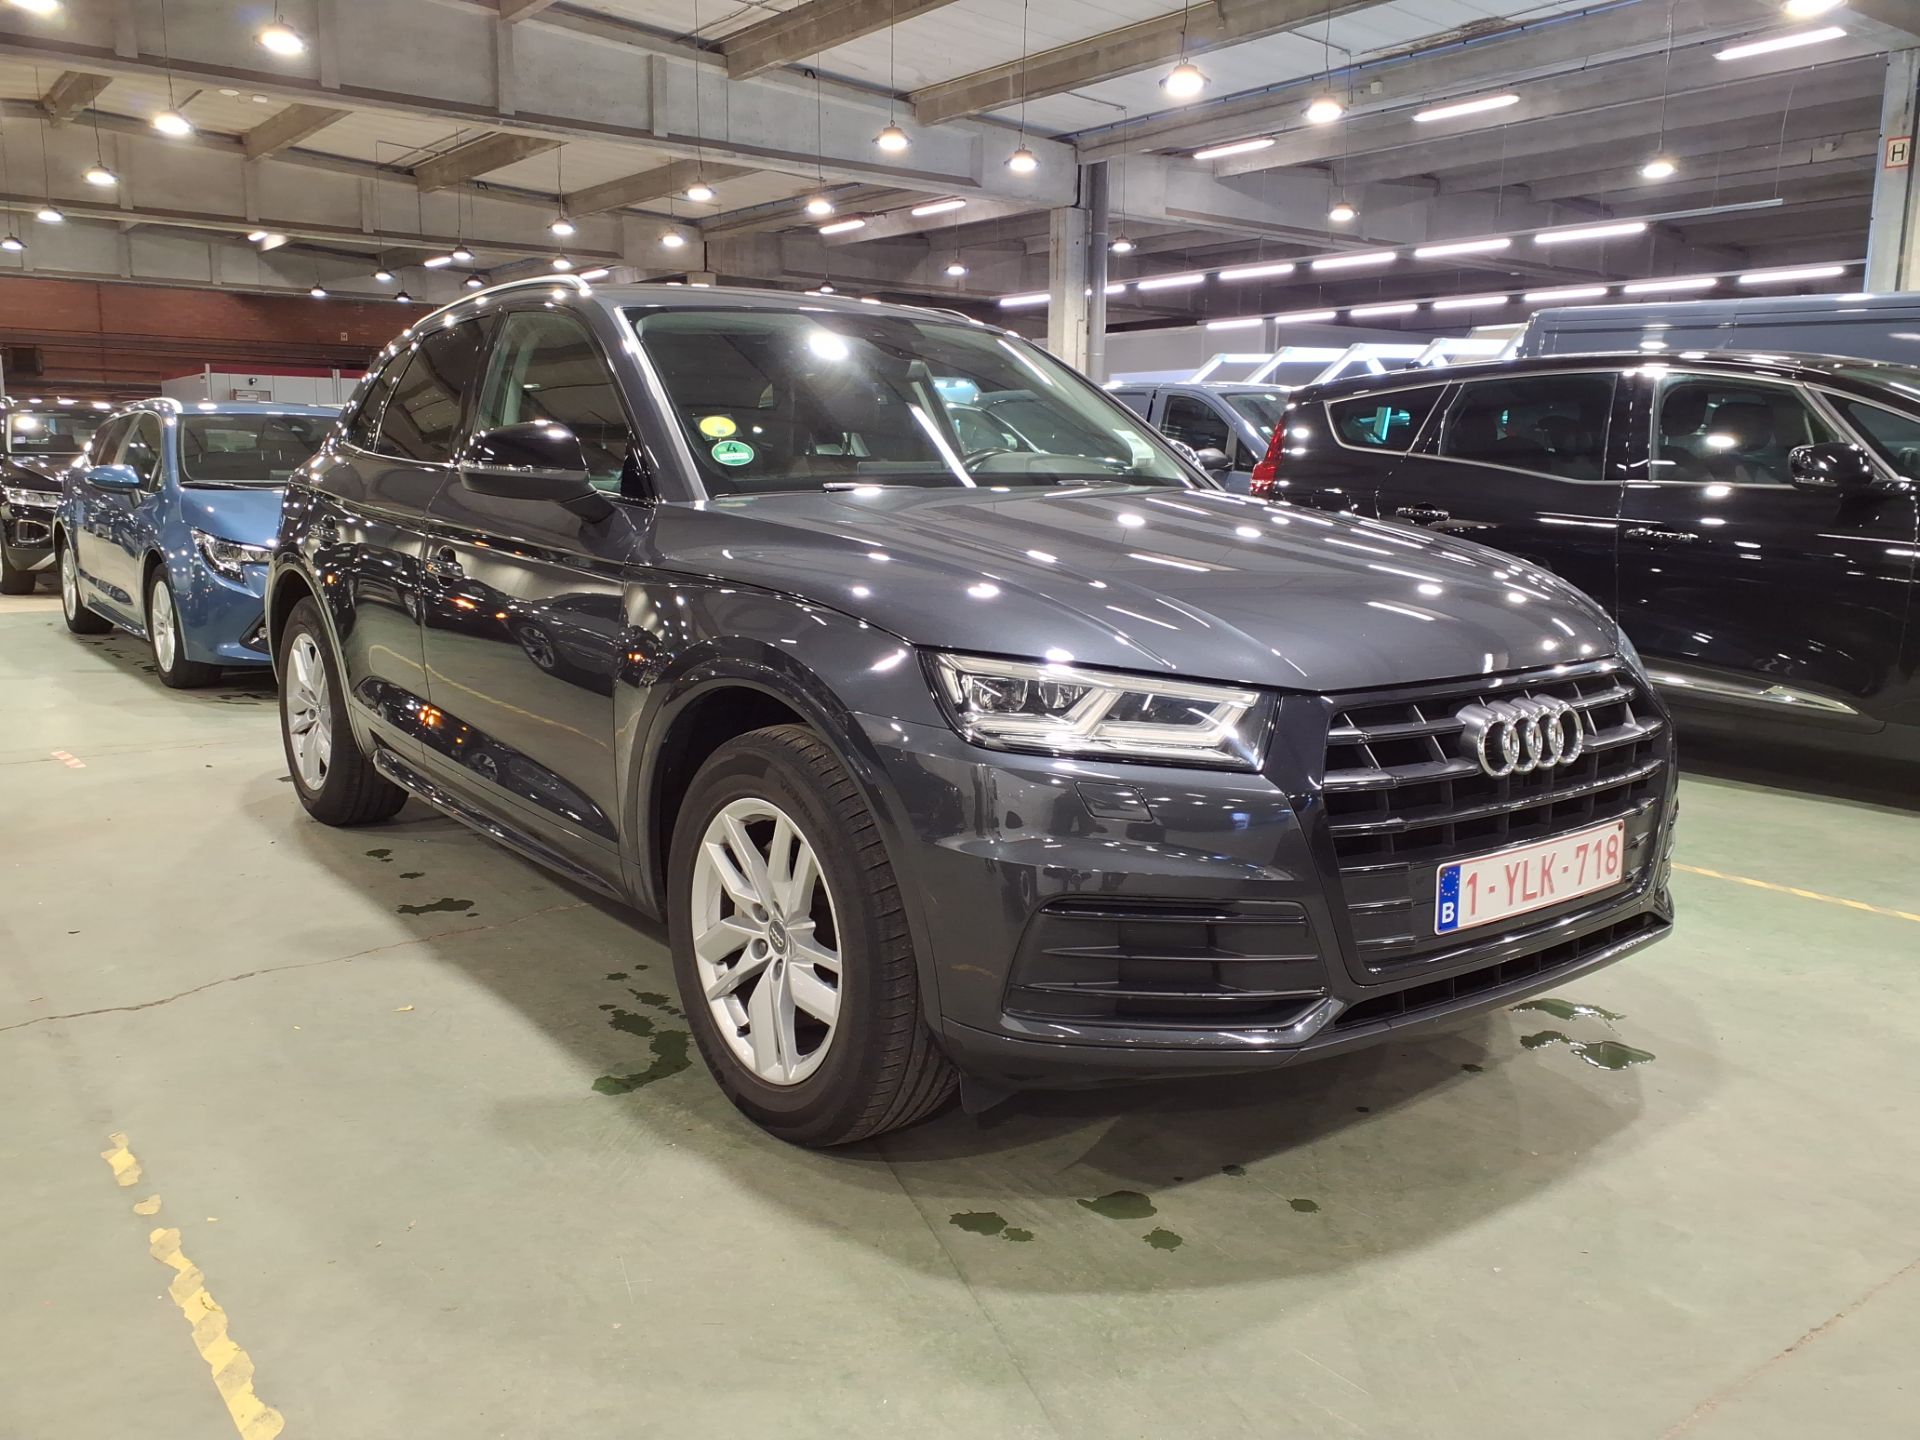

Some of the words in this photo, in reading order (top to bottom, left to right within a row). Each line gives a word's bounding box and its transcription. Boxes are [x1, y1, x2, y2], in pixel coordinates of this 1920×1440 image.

[1891, 143, 1905, 162] H
[726, 442, 738, 453] 4
[1466, 834, 1619, 915] 1-YLK-718
[1441, 902, 1455, 924] B
